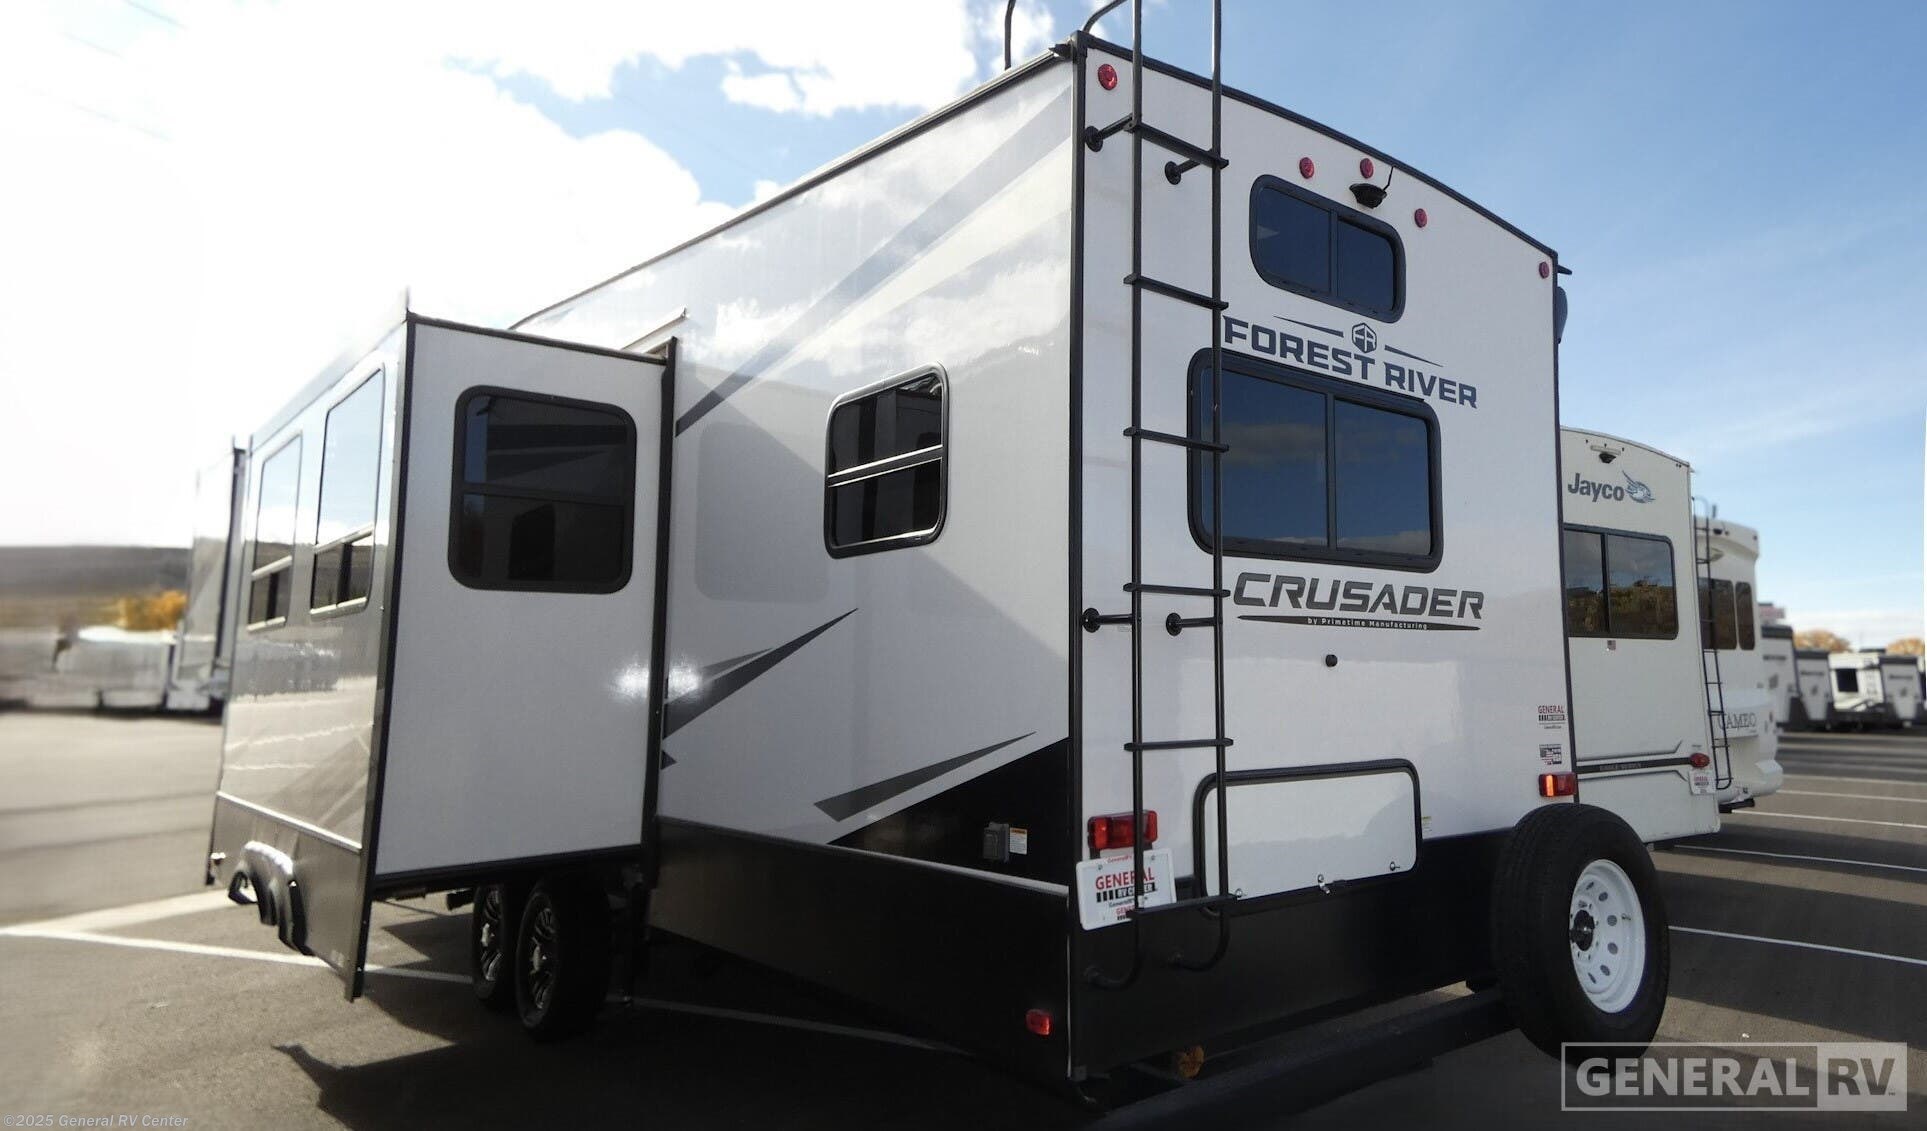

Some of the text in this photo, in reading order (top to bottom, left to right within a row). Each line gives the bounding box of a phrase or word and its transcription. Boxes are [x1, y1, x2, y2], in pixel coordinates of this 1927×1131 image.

[1223, 315, 1478, 409] FOREST RIVER
[1567, 472, 1625, 502] Jayco
[1233, 572, 1484, 619] CRUSADER
[1307, 617, 1428, 631] by Primetime Manufacturing
